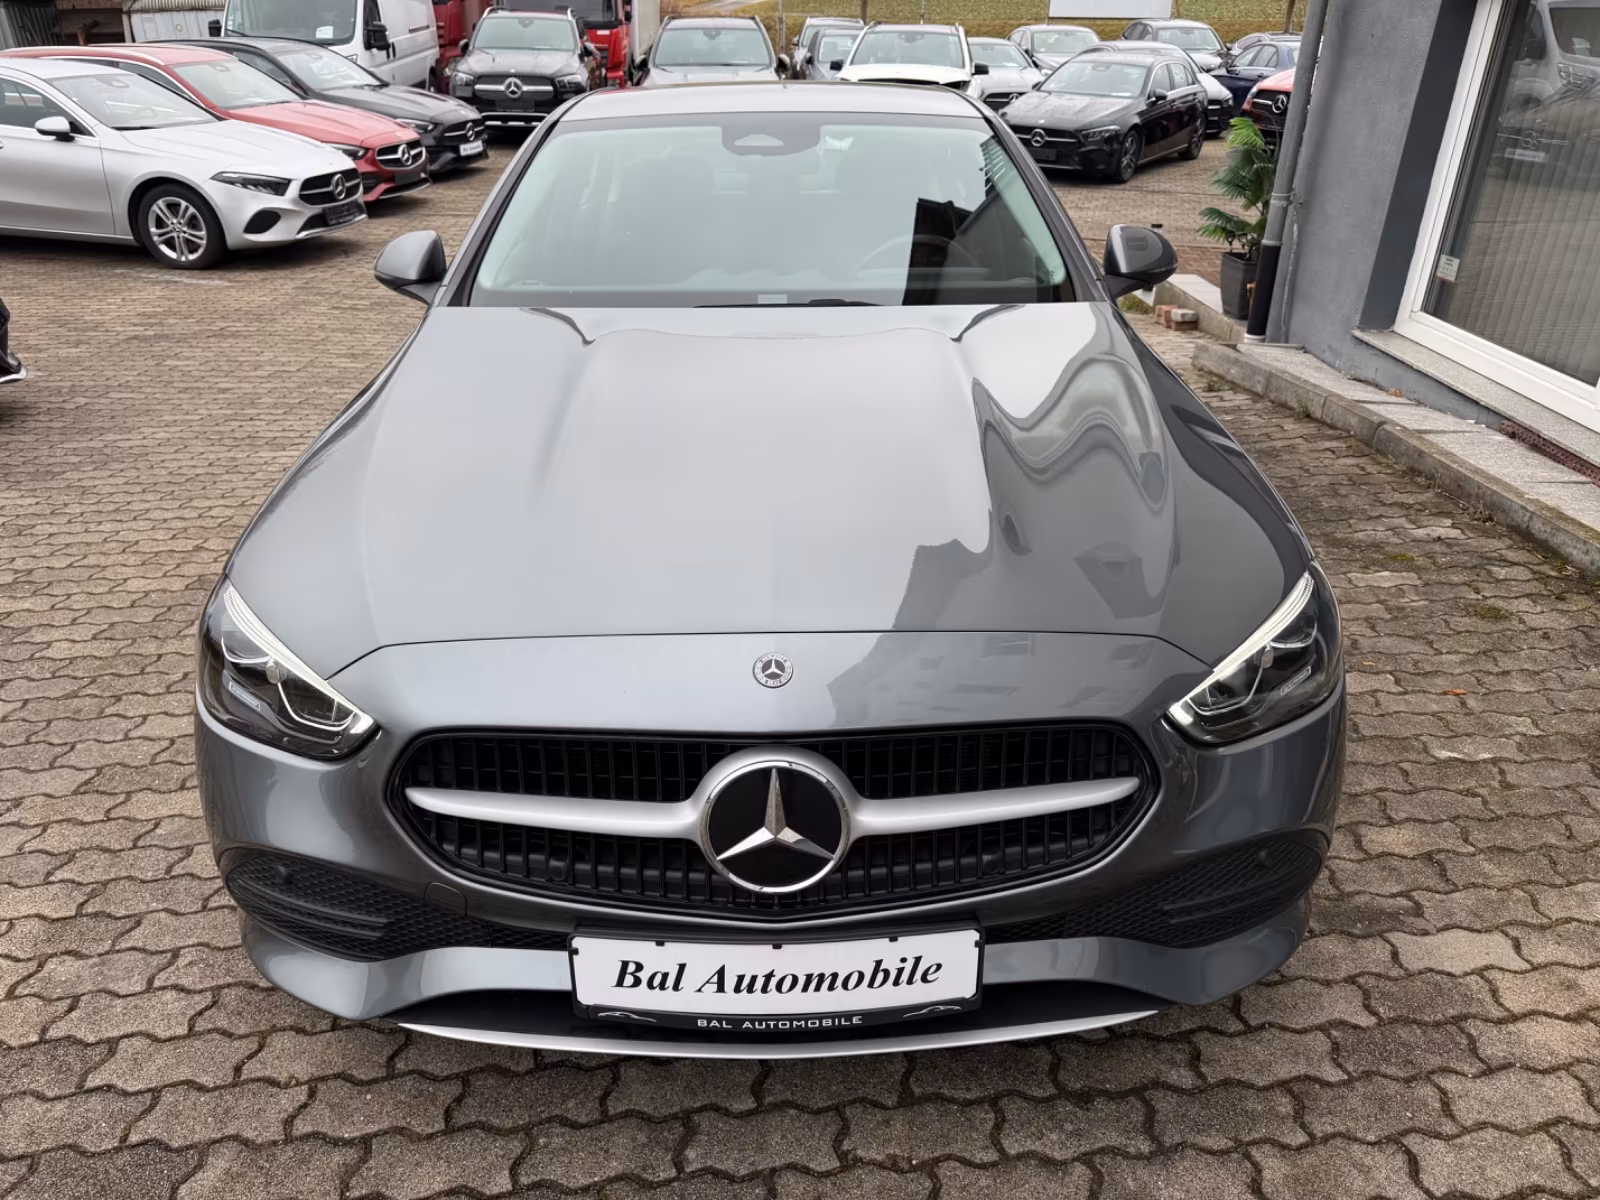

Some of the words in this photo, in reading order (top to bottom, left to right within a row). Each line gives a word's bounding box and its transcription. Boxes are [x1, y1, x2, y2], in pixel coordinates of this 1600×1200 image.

[611, 959, 687, 992] Bal
[694, 955, 943, 995] Automobile
[697, 1018, 732, 1028] BAL
[742, 1015, 863, 1029] AUTOMOBILE
